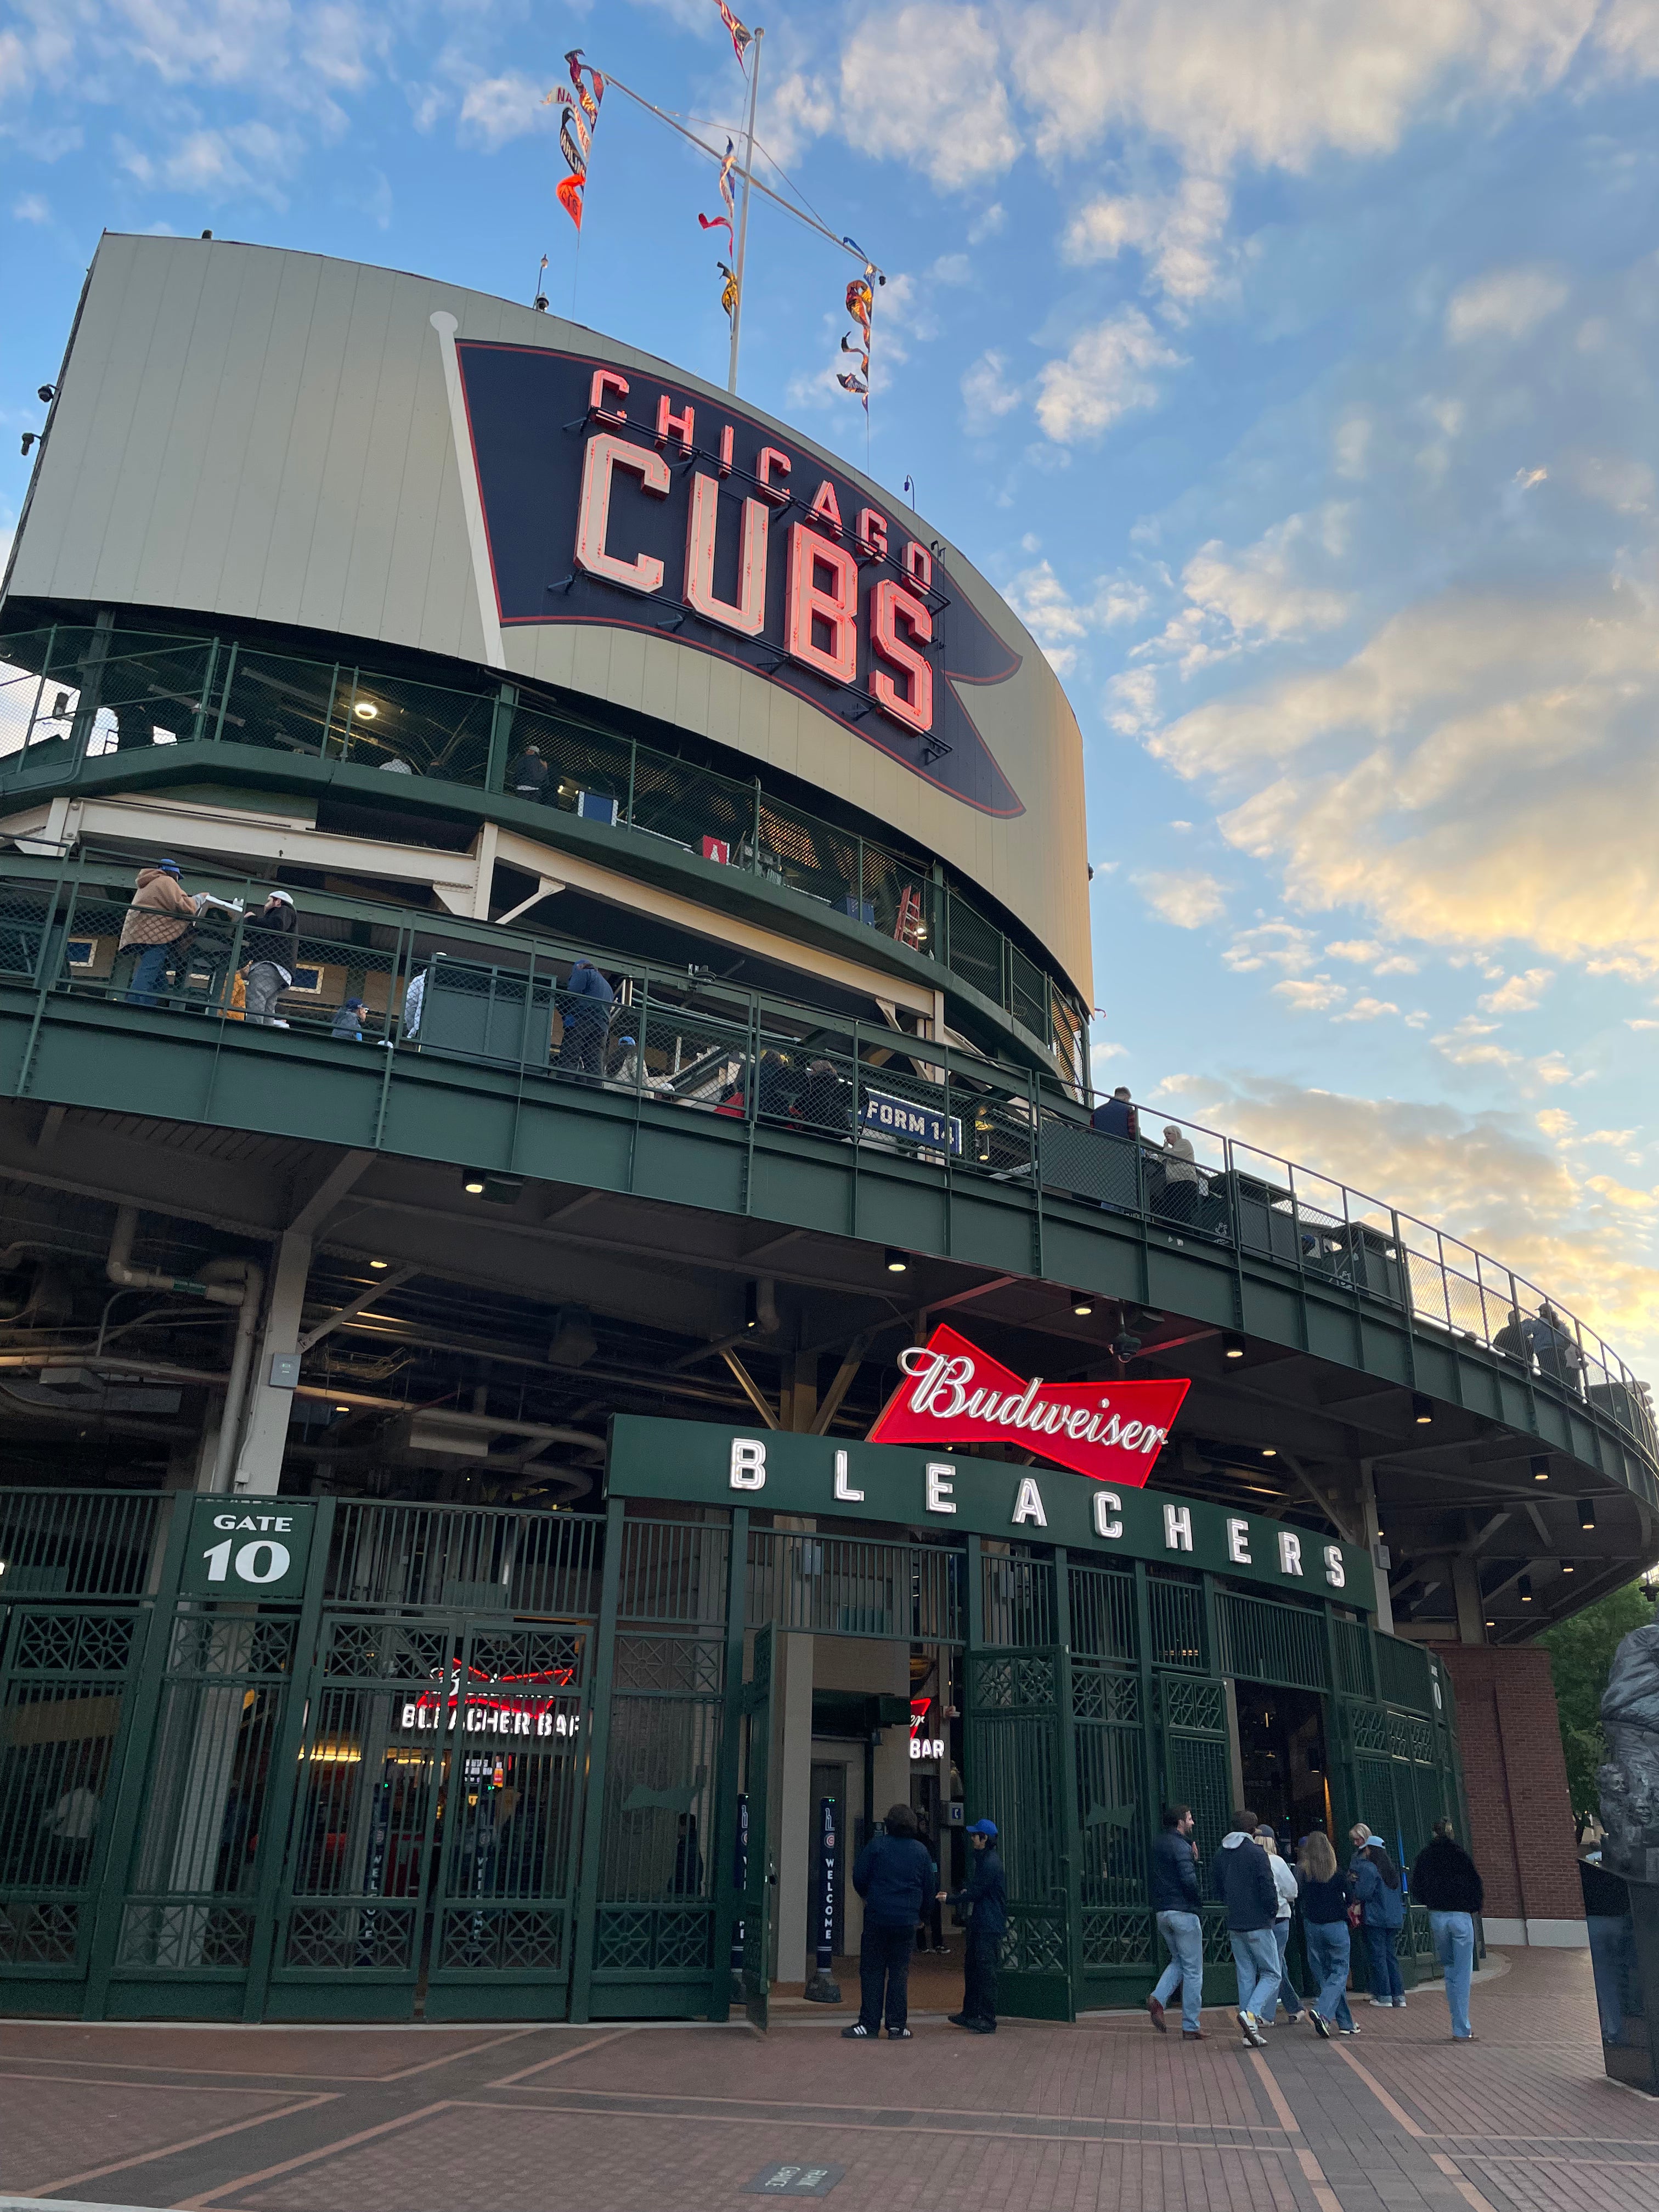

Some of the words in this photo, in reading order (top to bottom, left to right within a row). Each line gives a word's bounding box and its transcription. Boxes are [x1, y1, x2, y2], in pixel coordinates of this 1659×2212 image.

[590, 369, 932, 599] CHICAGO
[574, 432, 933, 737] CUBS
[859, 1101, 925, 1135] FORM
[897, 1346, 1169, 1453] Budweiser
[213, 1514, 293, 1532] GATE
[730, 1437, 1345, 1588] BLEACHERS
[202, 1538, 291, 1584] 10
[910, 1738, 945, 1759] BAR
[825, 1858, 835, 1940] WELCOME
